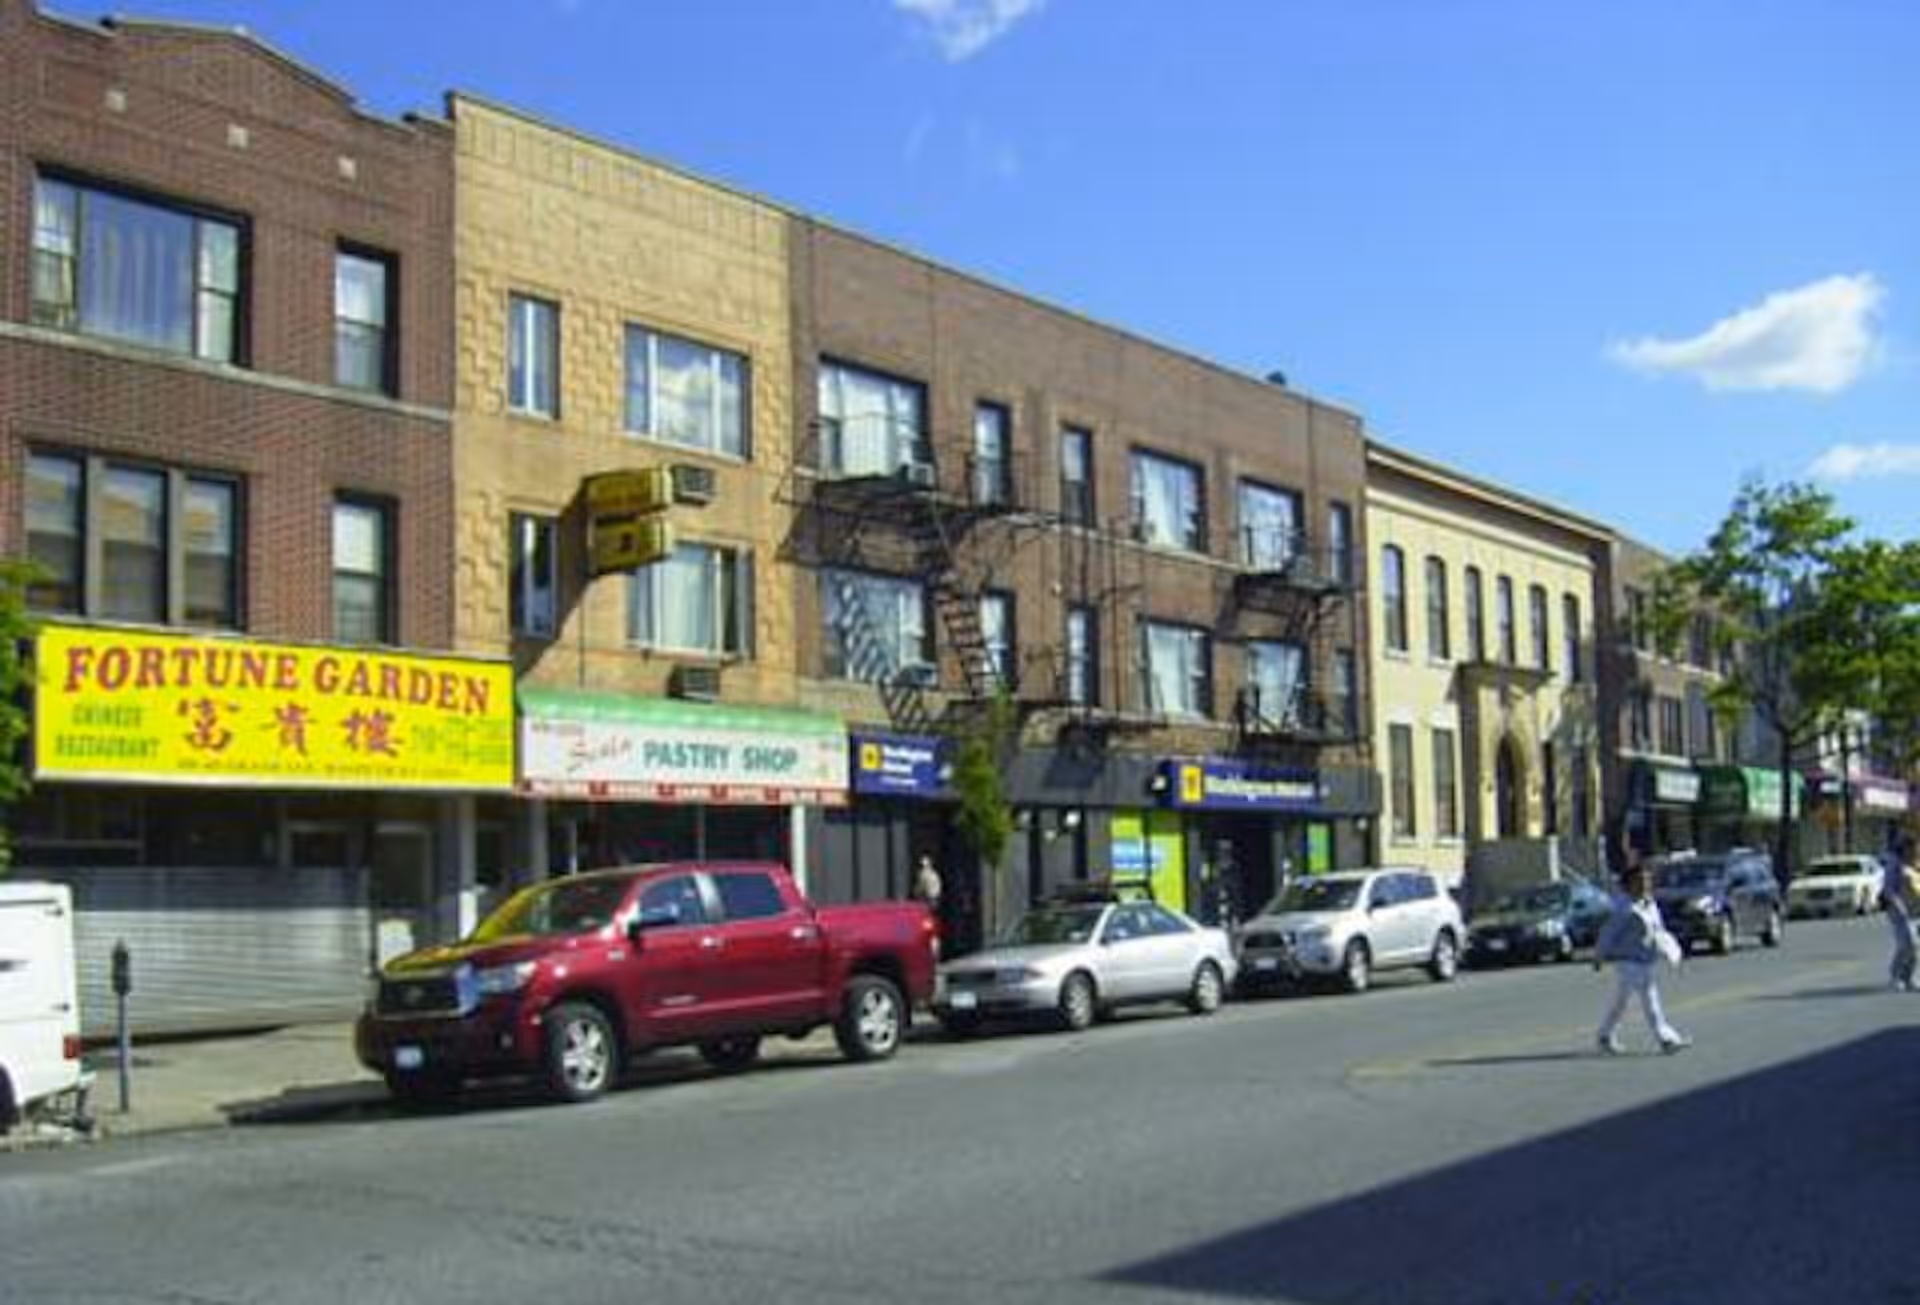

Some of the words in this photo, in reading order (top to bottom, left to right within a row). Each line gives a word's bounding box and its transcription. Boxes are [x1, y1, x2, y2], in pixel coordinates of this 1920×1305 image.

[64, 647, 300, 693] FORTUNE
[314, 656, 490, 714] GARDEN
[644, 741, 731, 771] PASTRY
[743, 748, 798, 772] SHOP
